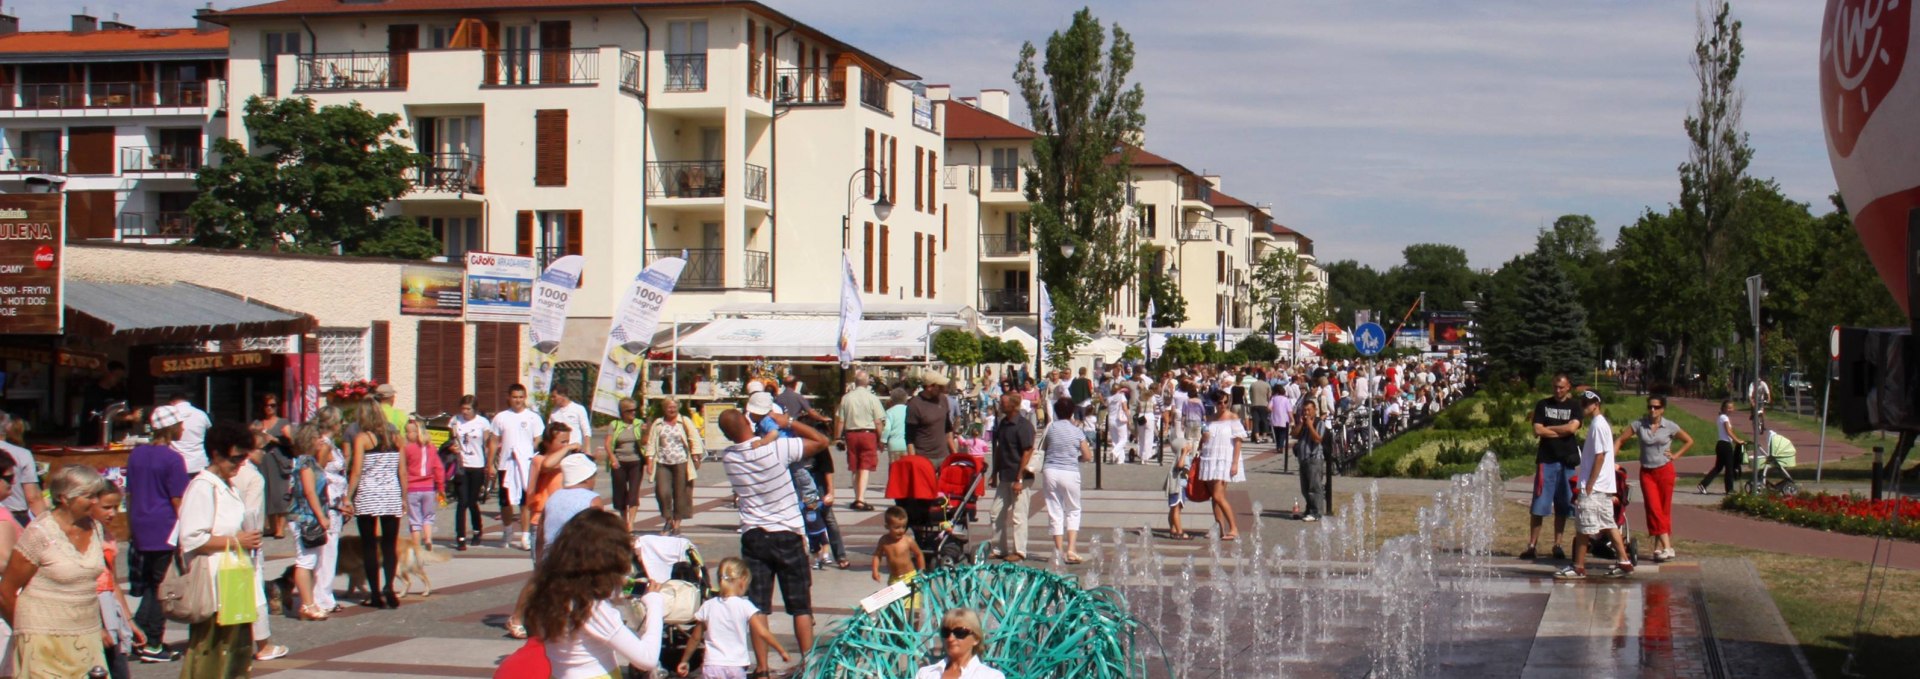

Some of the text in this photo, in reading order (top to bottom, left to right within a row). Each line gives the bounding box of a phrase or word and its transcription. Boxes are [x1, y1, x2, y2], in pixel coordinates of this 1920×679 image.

[0, 265, 24, 273] CAMY
[22, 286, 51, 294] FRYTKI
[539, 286, 568, 303] 1000
[635, 286, 663, 305] 1000
[8, 297, 25, 305] HOT
[27, 297, 47, 305] DOG
[59, 353, 100, 369] PIWO
[232, 352, 262, 366] PIWO
